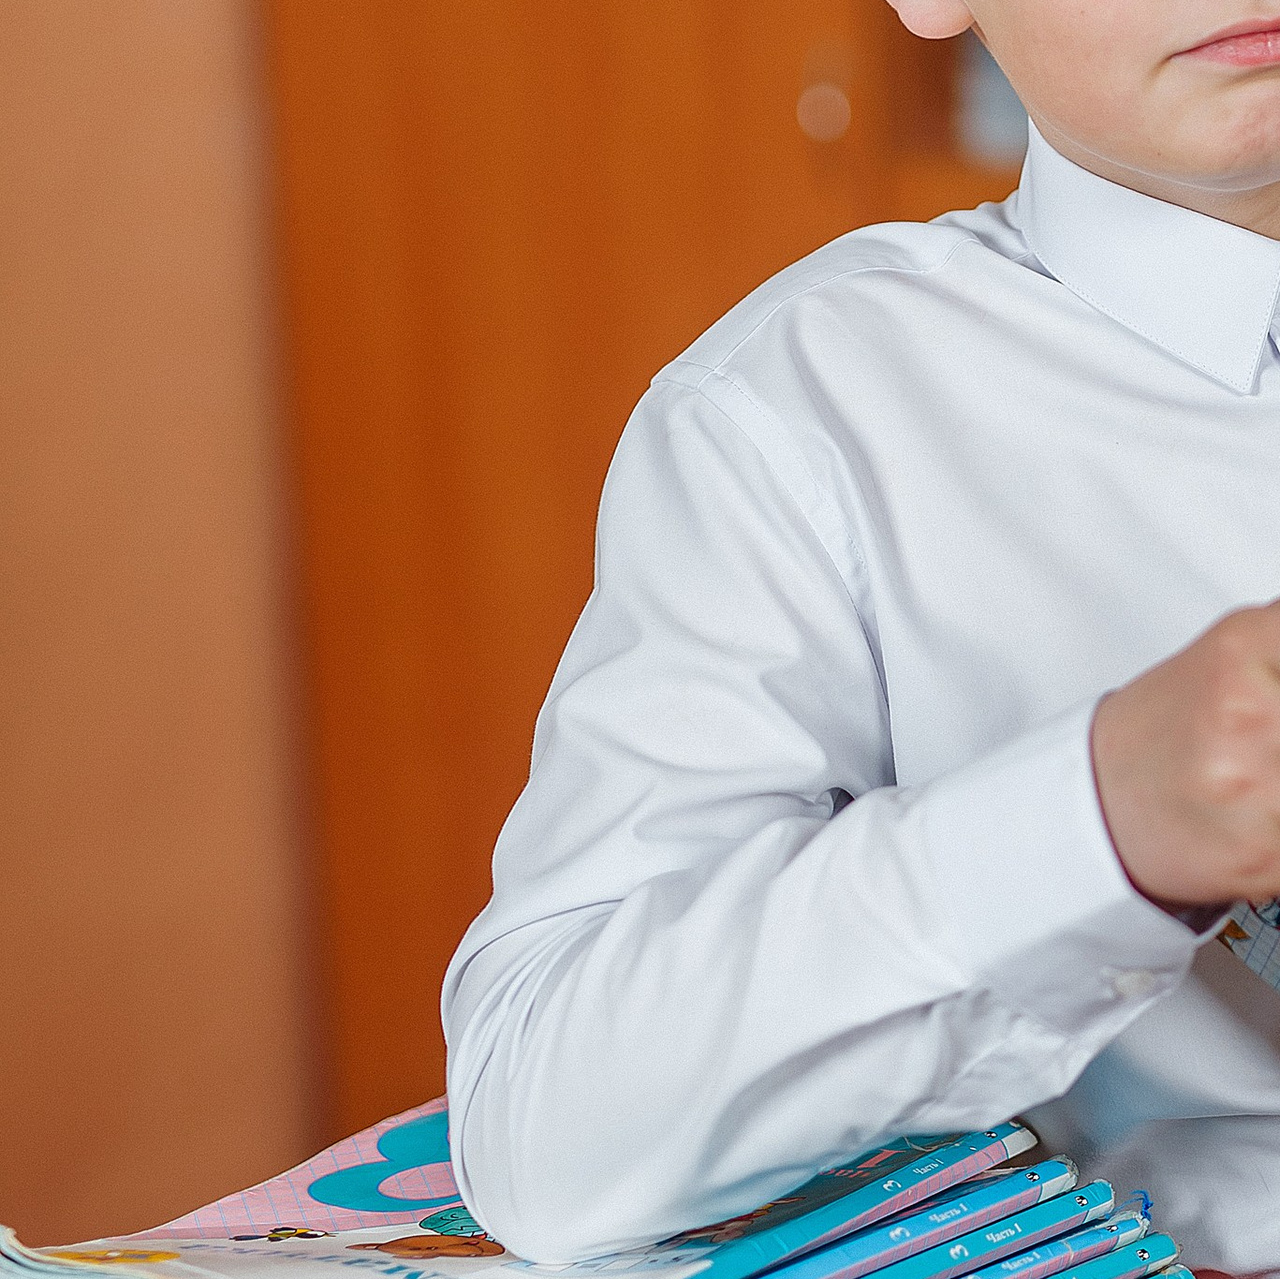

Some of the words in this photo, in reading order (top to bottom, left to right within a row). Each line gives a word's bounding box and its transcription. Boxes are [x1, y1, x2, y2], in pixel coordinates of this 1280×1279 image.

[912, 1162, 939, 1174] Часть
[929, 1208, 960, 1223] Часть
[986, 1227, 1015, 1242] Часть
[1002, 1256, 1034, 1270] Часть
